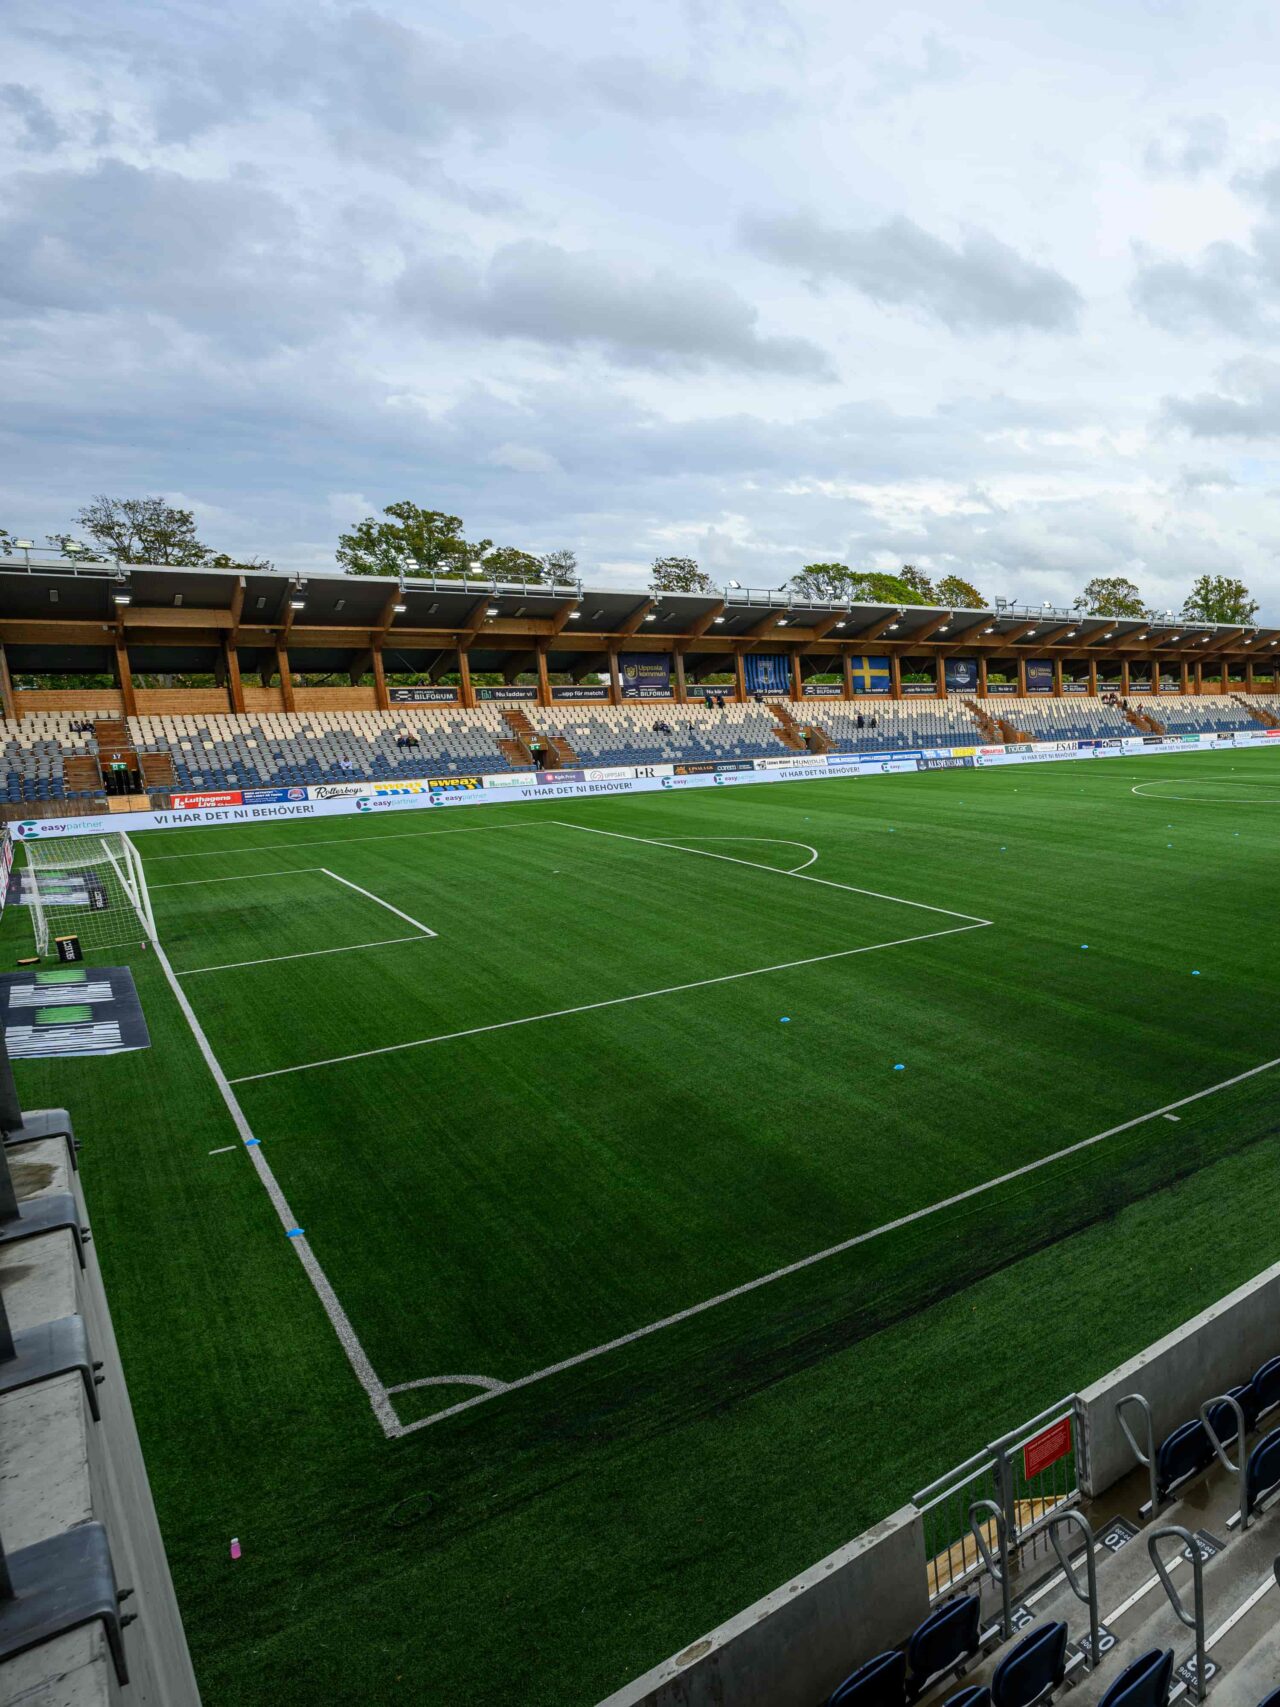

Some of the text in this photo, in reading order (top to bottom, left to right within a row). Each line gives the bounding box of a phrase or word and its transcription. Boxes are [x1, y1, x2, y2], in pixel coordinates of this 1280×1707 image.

[828, 766, 860, 774] BEHÖVER!
[428, 777, 478, 786] sweax
[315, 787, 364, 799] Rollerboys
[521, 782, 633, 798] VI HAR DET NI BEHÖVER!
[184, 795, 231, 803] Luthagens
[373, 797, 418, 808] easypartner
[445, 792, 487, 802] easypartner
[154, 815, 168, 824] VI
[173, 812, 202, 823] HAR
[205, 810, 229, 821] DET
[234, 809, 249, 819] NI
[252, 804, 315, 817] BEHÖVER!
[41, 820, 104, 832] easypartner
[1104, 1533, 1126, 1552] 01
